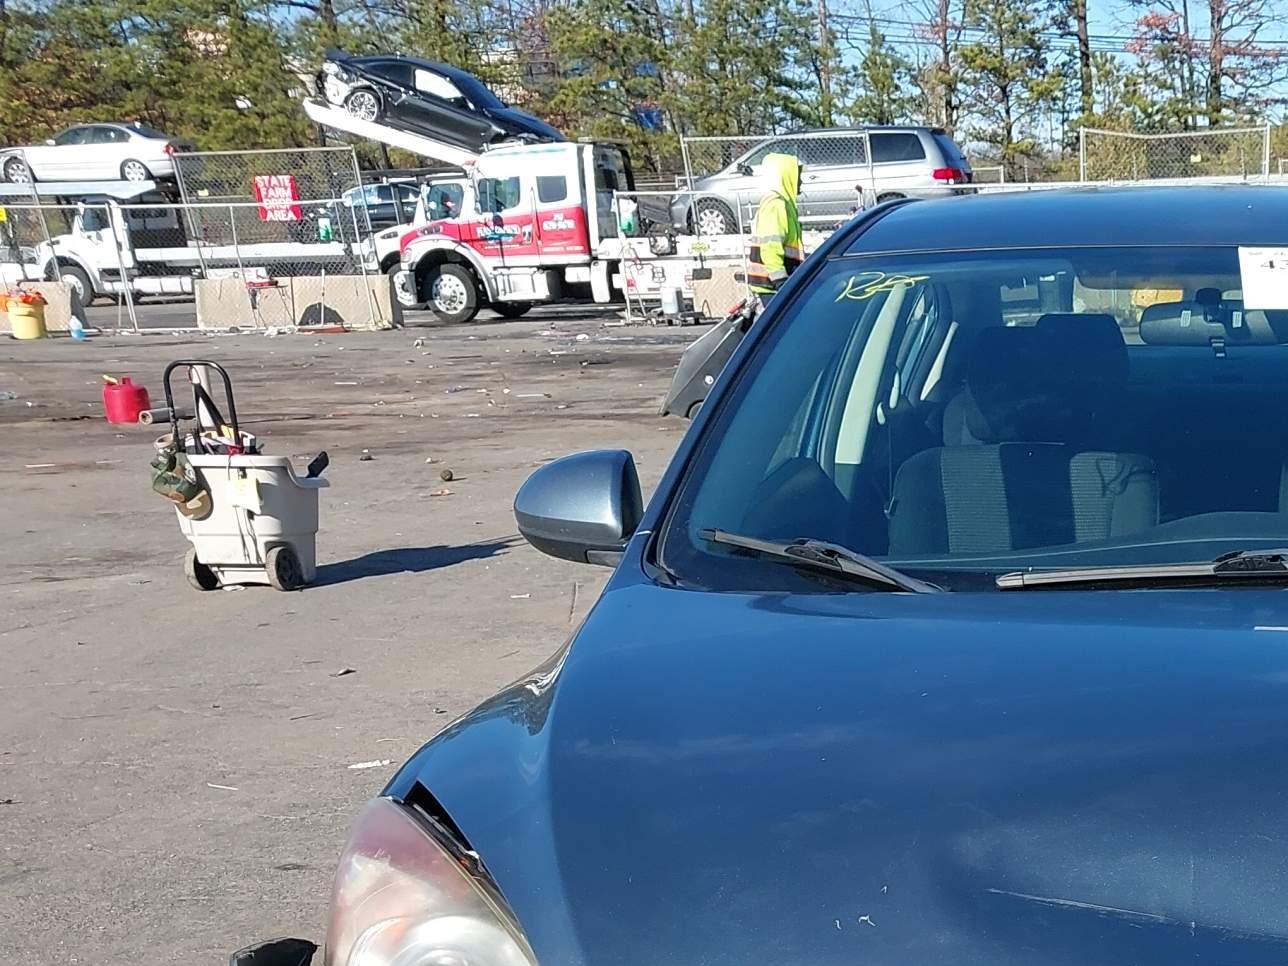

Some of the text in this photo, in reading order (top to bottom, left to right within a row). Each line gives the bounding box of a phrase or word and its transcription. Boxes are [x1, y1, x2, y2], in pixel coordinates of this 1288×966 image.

[255, 175, 291, 188] STATE
[260, 187, 292, 199] FARM
[266, 209, 298, 221] AREA
